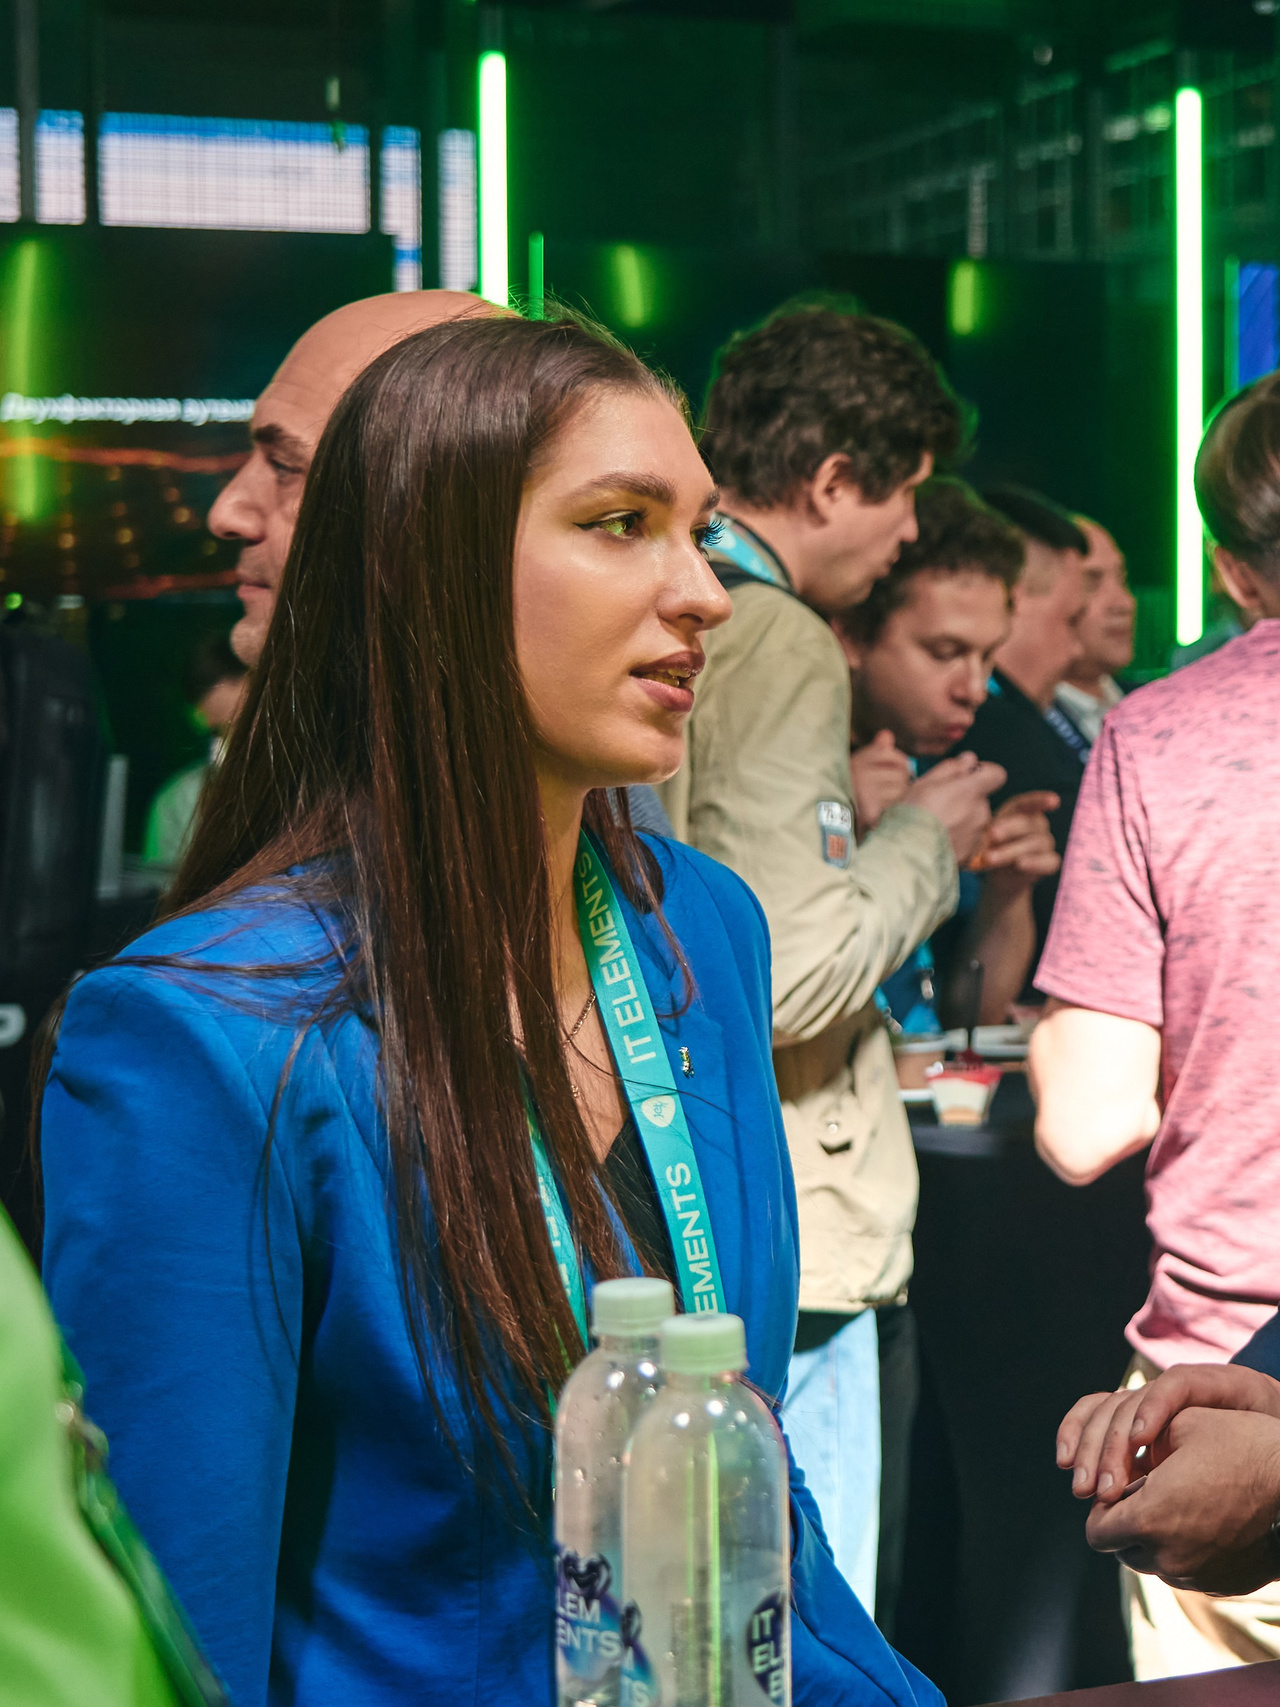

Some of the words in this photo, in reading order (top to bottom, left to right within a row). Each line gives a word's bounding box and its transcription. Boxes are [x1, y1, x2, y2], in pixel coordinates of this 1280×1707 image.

[578, 852, 645, 1027] ELEMENTS
[623, 1034, 656, 1064] IT
[752, 1608, 775, 1640] IT
